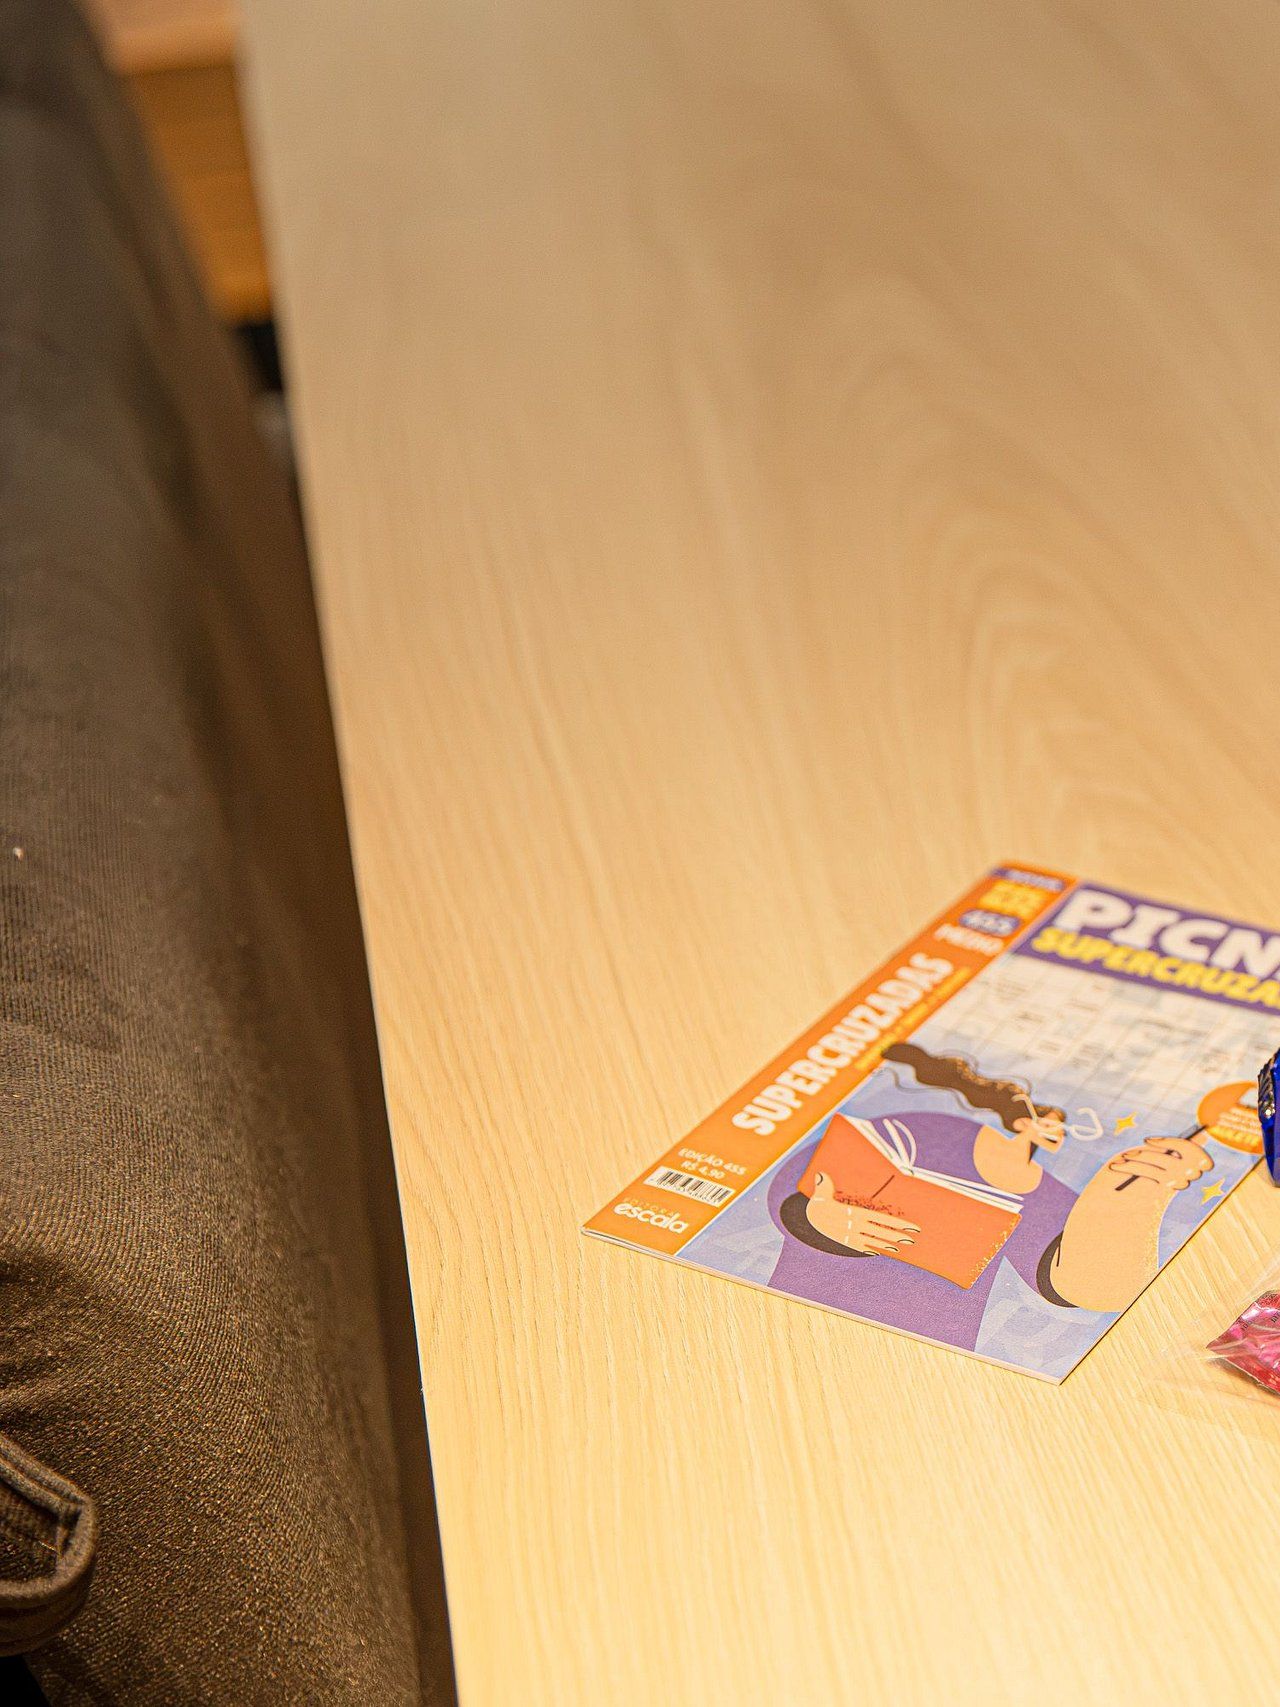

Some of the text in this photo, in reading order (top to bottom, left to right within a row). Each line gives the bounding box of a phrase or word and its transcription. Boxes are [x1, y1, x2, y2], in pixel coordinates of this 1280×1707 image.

[732, 951, 954, 1137] SUPERCRUZADAS
[678, 1147, 724, 1167] EDIÇÃO
[681, 1160, 699, 1171] R$
[613, 1203, 689, 1234] escala
